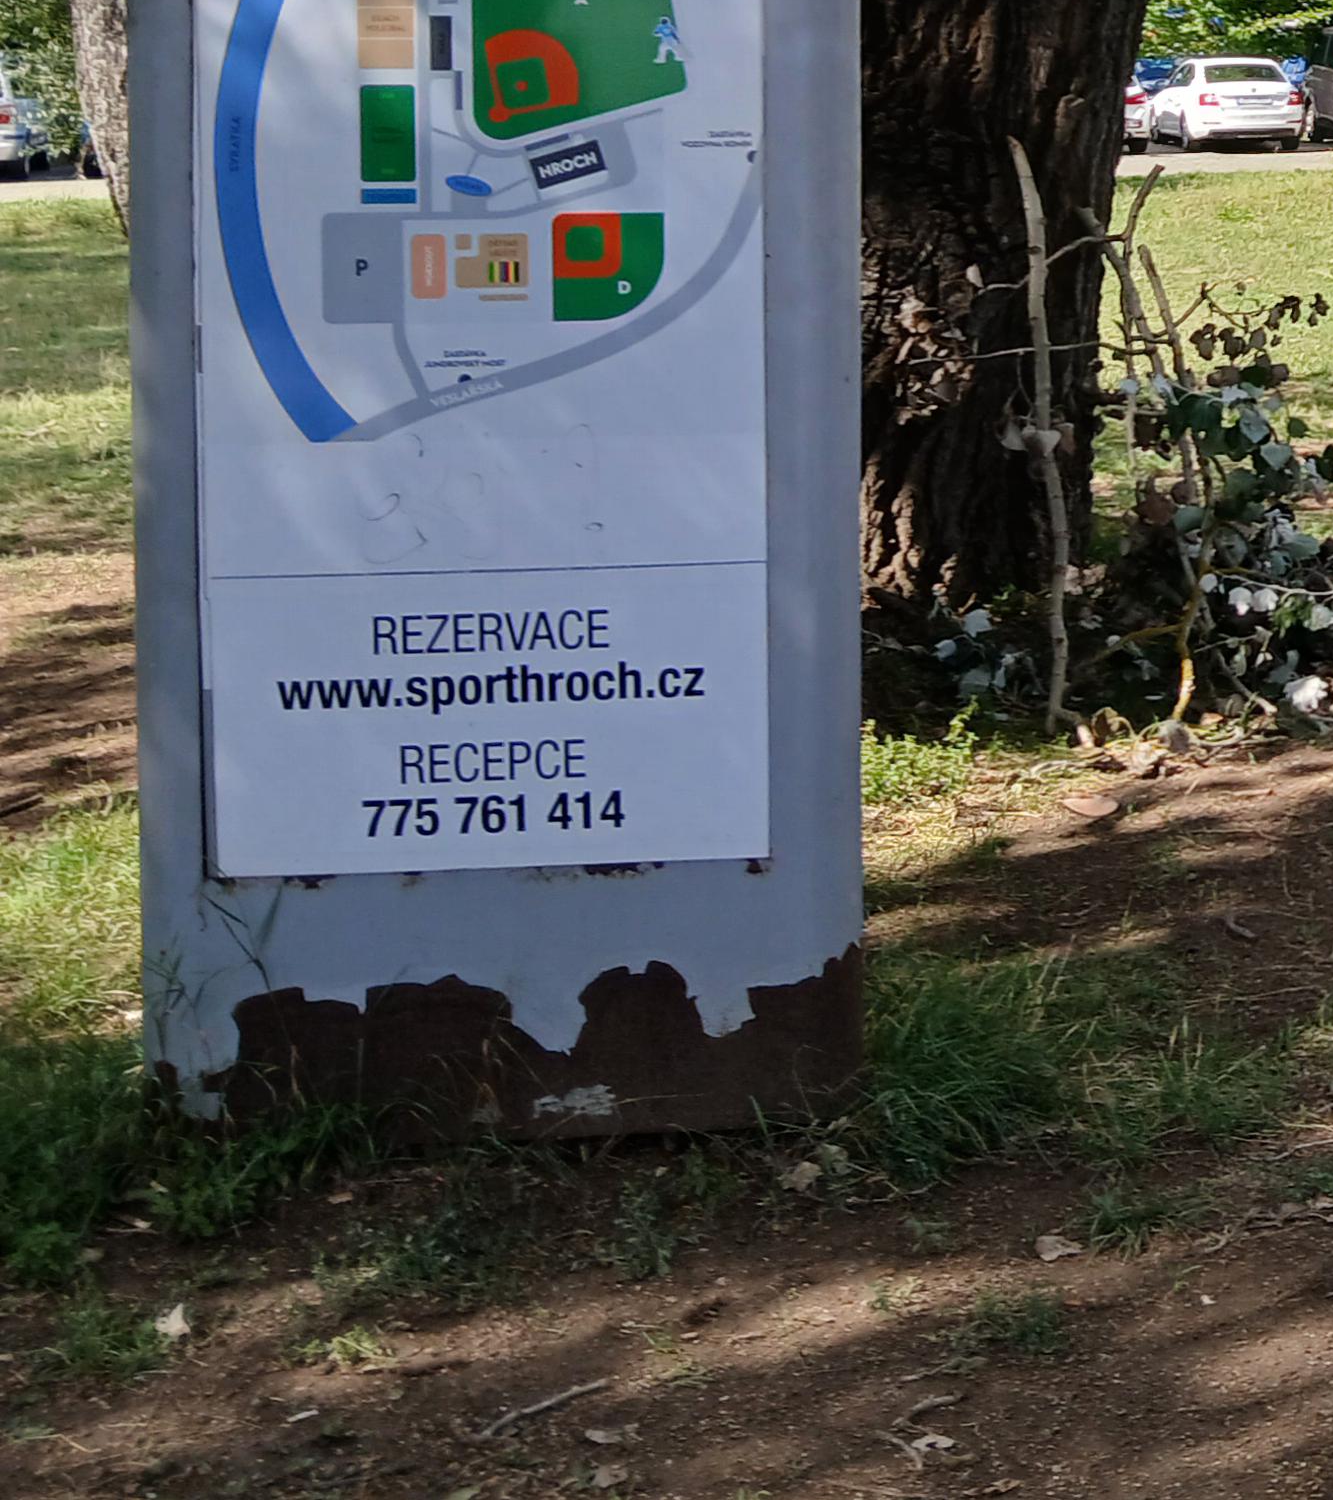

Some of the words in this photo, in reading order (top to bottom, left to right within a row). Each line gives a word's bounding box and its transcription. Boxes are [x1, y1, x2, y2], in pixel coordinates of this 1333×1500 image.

[538, 152, 598, 180] HROCH
[355, 258, 369, 277] P
[617, 280, 632, 295] D
[373, 610, 609, 655] REZERVACE
[277, 661, 705, 715] www.sporthroch.cz
[400, 739, 586, 784] RECEPCE
[362, 797, 440, 838] 775
[454, 794, 527, 834] 761
[547, 790, 625, 831] 414
